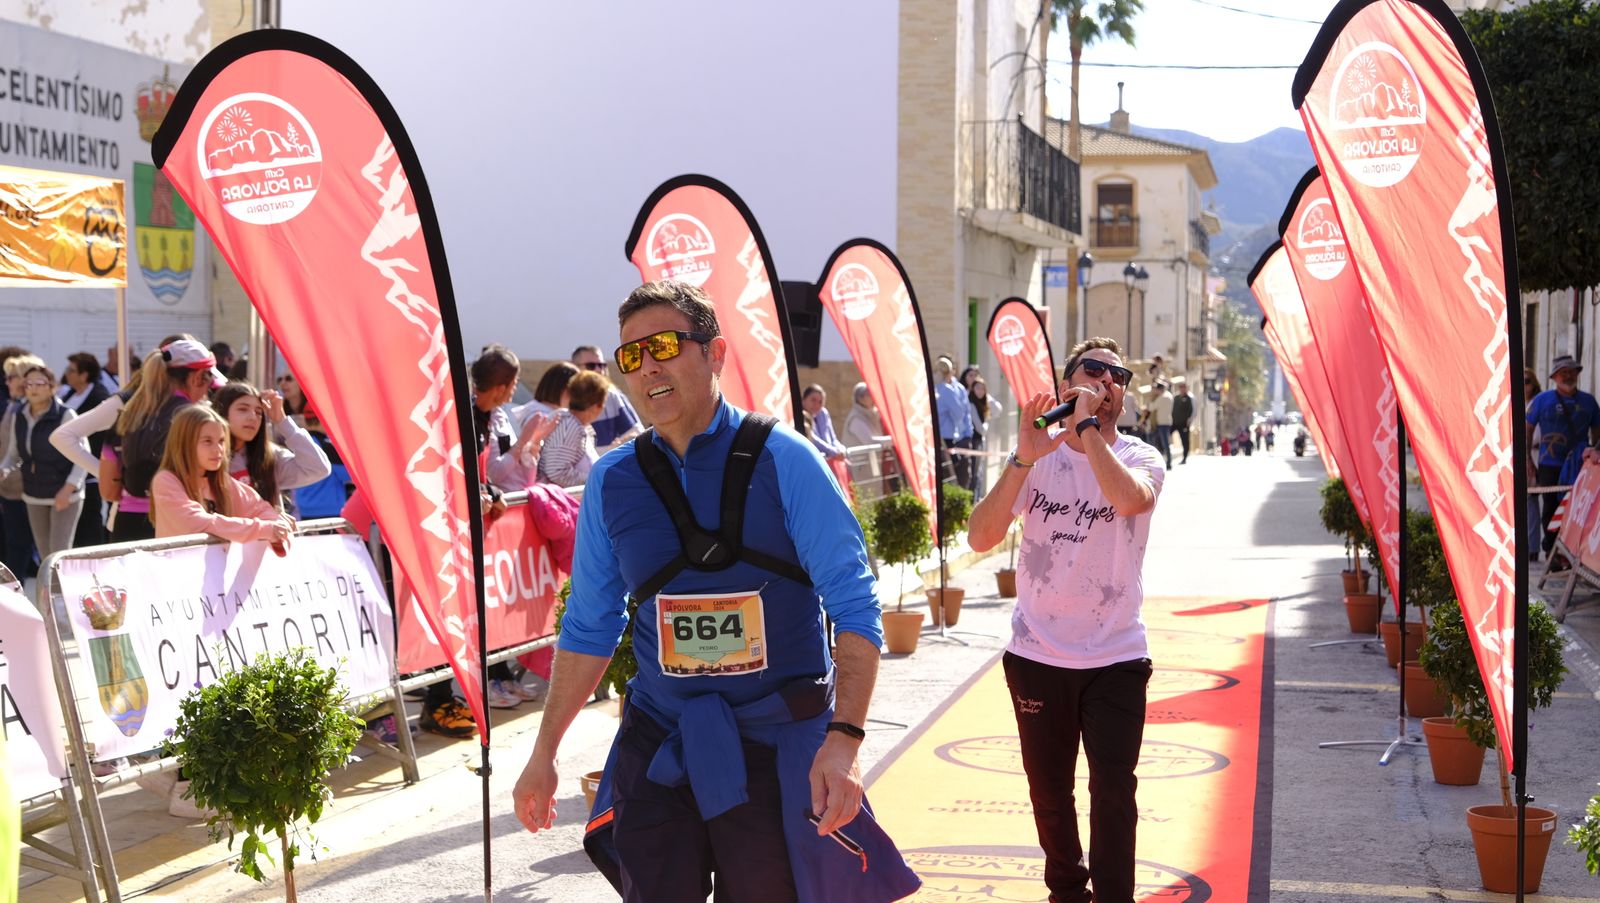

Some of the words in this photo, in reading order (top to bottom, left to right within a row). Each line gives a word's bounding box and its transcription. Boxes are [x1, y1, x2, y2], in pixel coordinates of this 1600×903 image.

[0, 121, 119, 170] UNTAMIENTO
[1029, 488, 1071, 523] Pepe
[151, 579, 328, 627] AYUNTAMIENTO
[336, 574, 365, 597] DE
[158, 605, 378, 690] CANTORIA
[673, 613, 743, 641] 664
